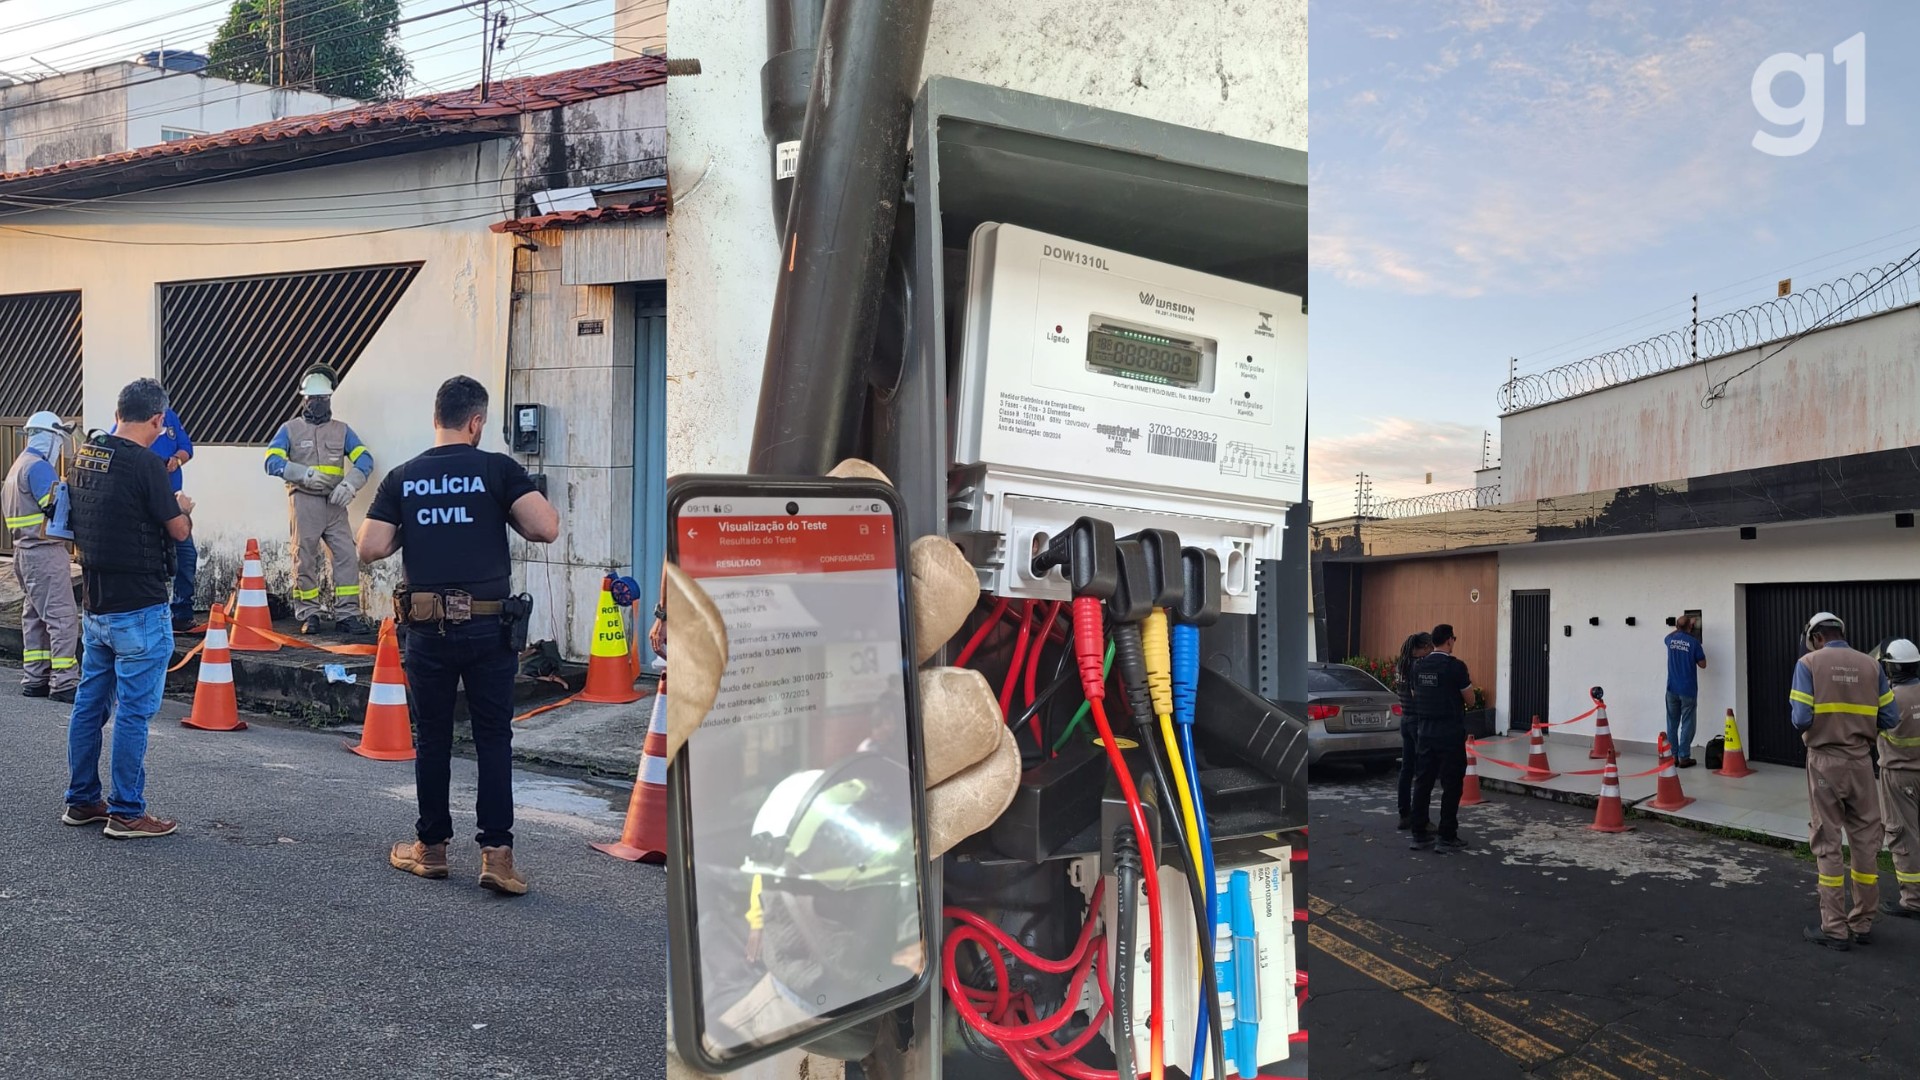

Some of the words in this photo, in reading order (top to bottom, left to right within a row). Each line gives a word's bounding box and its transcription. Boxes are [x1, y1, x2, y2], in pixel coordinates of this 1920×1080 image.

[1043, 245, 1110, 271] DOW1310L
[1155, 298, 1196, 316] WASION
[1046, 332, 1070, 344] Ligado
[1239, 362, 1265, 374] Wh/pulso
[1113, 381, 1134, 390] Portaria
[1000, 392, 1020, 401] Medidor
[1051, 401, 1068, 410] Energia
[998, 408, 1015, 417] Classe
[1005, 400, 1019, 409] Fases
[1047, 407, 1071, 417] Elementos
[998, 415, 1015, 424] Tampa
[998, 423, 1008, 431] Ano
[1015, 426, 1042, 437] fabricação:
[1148, 422, 1218, 443] 3703-052939-2
[80, 448, 110, 458] POLÍCIA
[403, 474, 486, 497] POLÍCIA
[687, 504, 710, 513] 09:11
[417, 506, 474, 525] CIVIL
[718, 521, 785, 534] Visualização
[786, 521, 799, 531] do
[801, 520, 828, 531] Teste
[719, 535, 761, 546] Resultado
[762, 535, 772, 545] do
[775, 535, 797, 544] Teste
[716, 559, 761, 568] RESULTADO
[820, 553, 875, 564] CONFIGURAÇÕES
[607, 620, 619, 628] DE
[733, 634, 768, 644] estimada:
[1670, 638, 1691, 648] PERÍCIA
[728, 651, 764, 662] egistrada:
[764, 647, 785, 657] 0,340
[785, 645, 802, 654] kWh
[740, 665, 755, 675] 977
[741, 681, 751, 690] de
[752, 678, 791, 689] calibração:
[716, 700, 727, 710] de
[727, 696, 767, 709] calibração:
[731, 715, 742, 724] da
[783, 705, 793, 715] 24
[793, 703, 817, 713] meses
[1271, 867, 1280, 892] elgin
